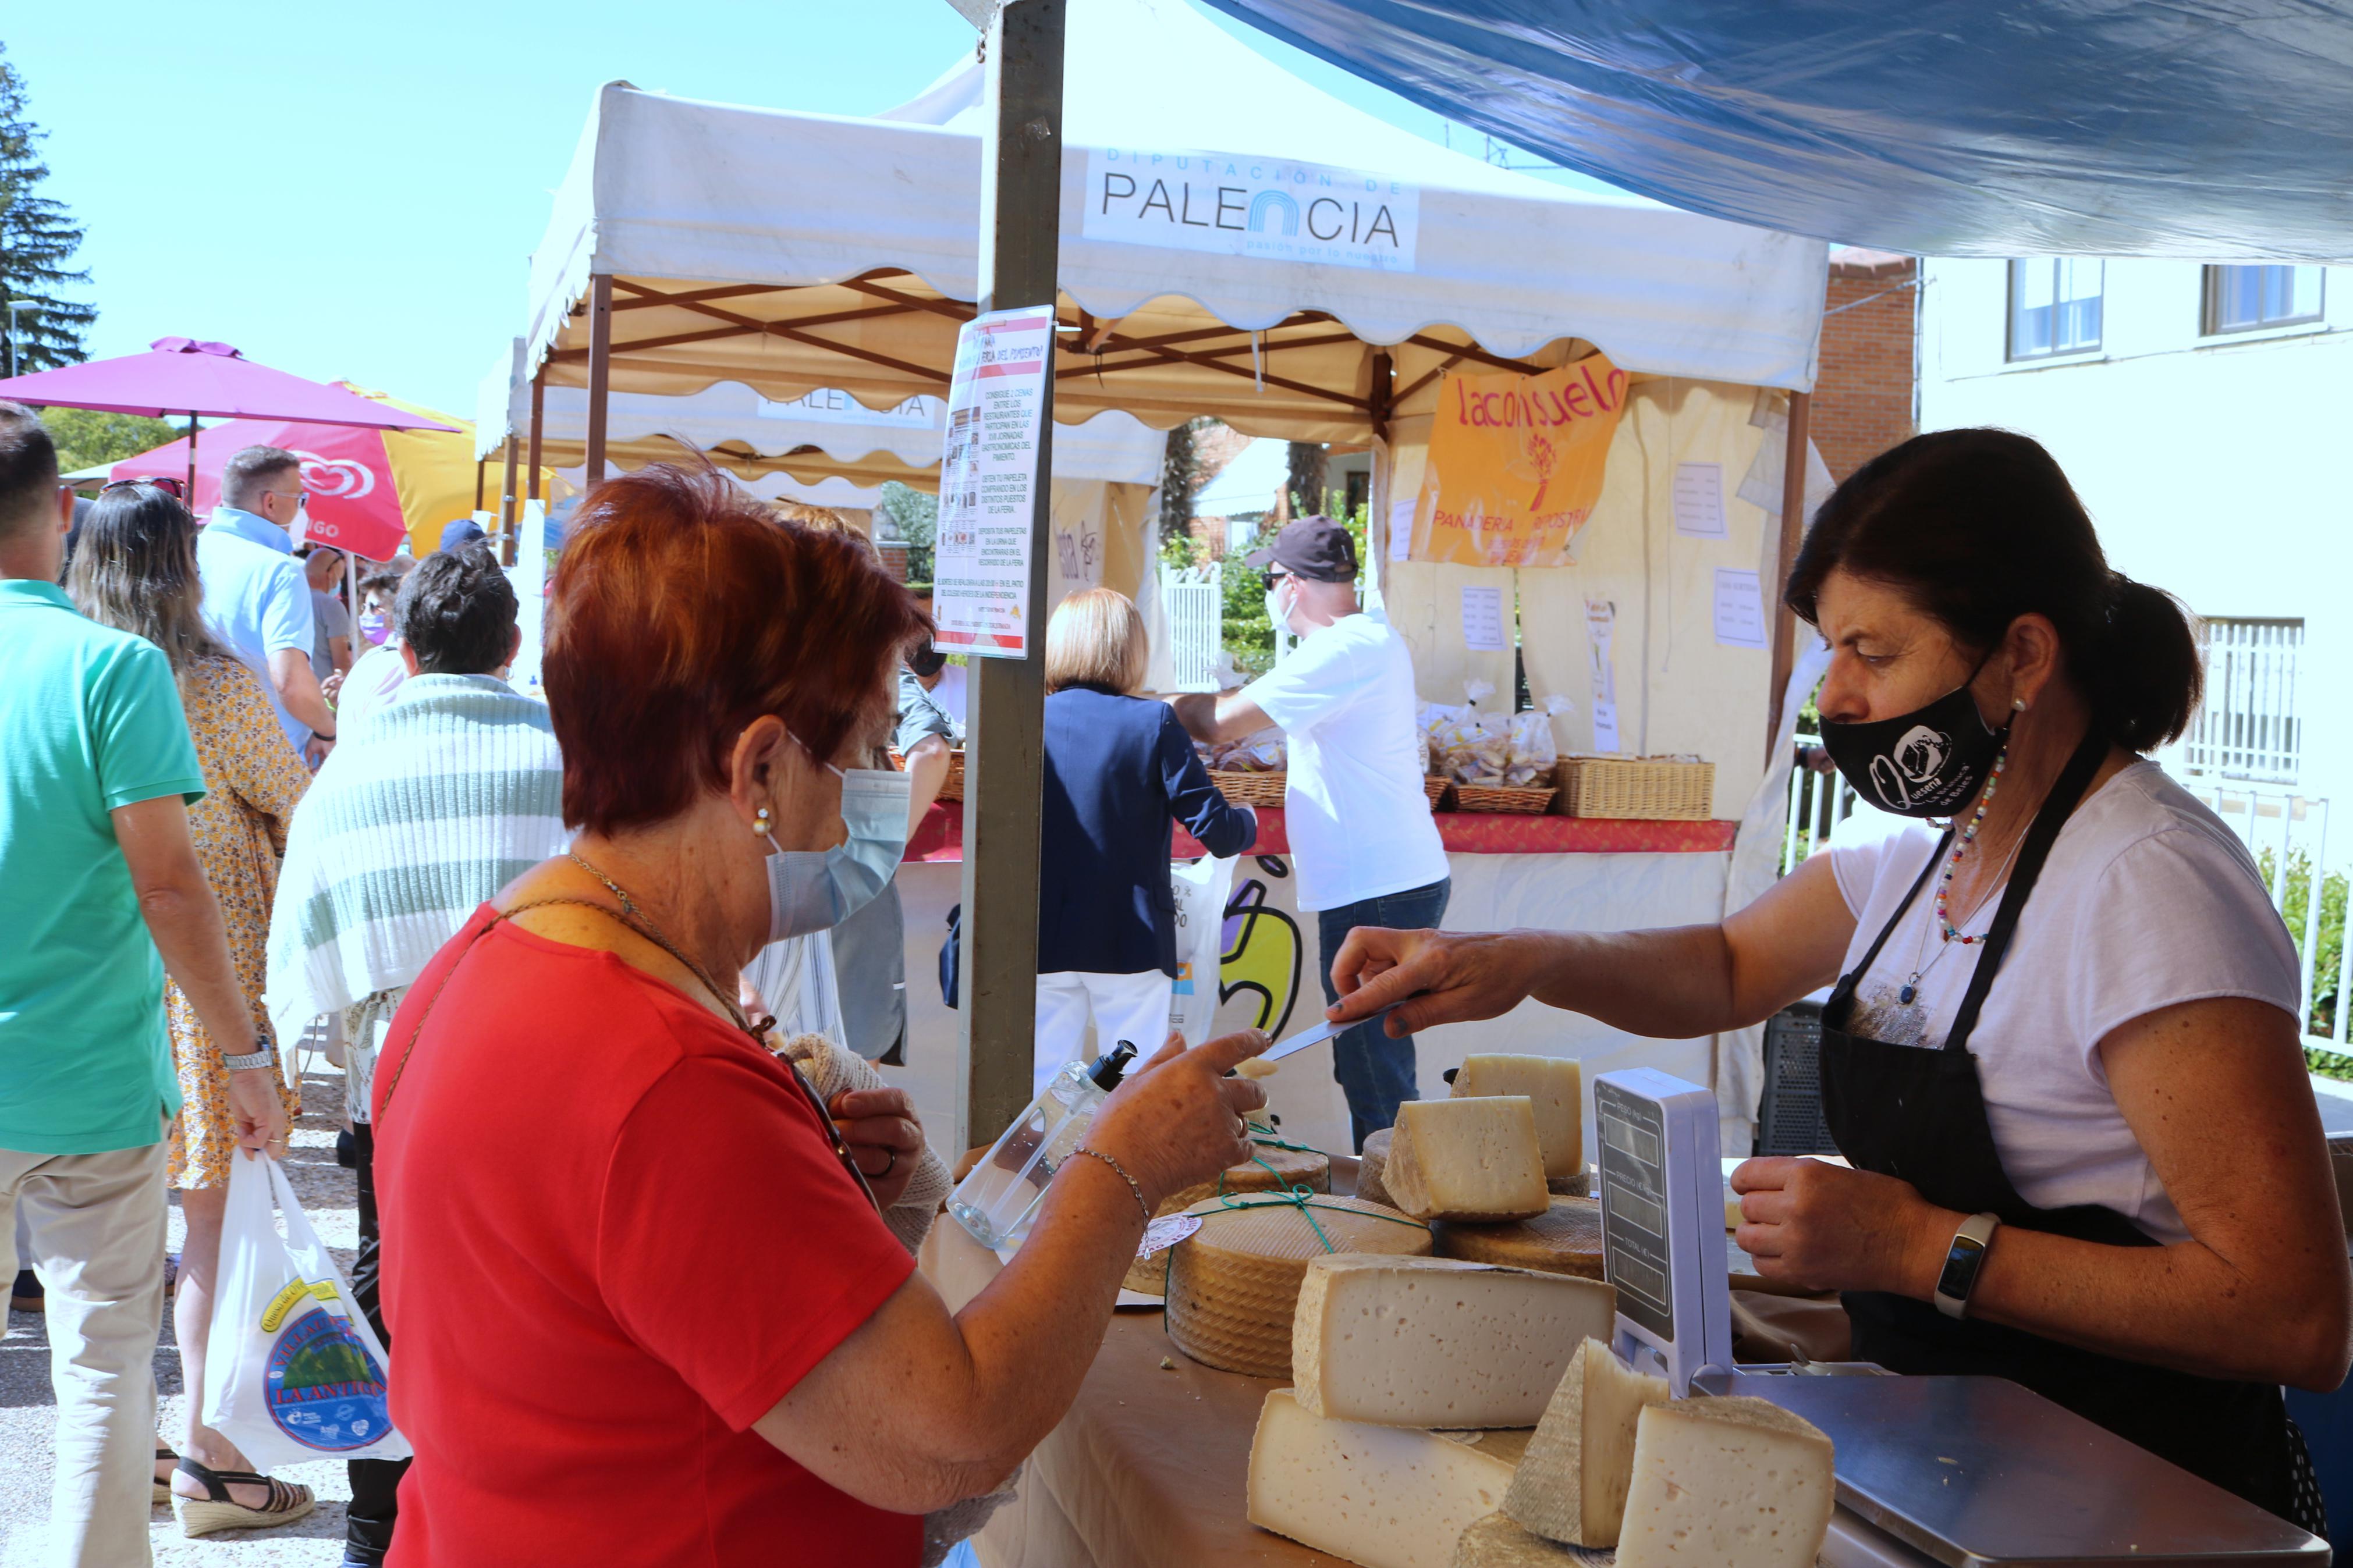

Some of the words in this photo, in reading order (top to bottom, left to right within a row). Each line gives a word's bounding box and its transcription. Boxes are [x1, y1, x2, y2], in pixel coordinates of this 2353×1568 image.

[1107, 147, 1332, 187] DIPUTACIÓN
[1365, 178, 1400, 195] DE
[1247, 239, 1293, 253] pasión
[1300, 246, 1322, 256] por
[1327, 247, 1340, 258] lo
[1346, 250, 1398, 264] nuestro
[985, 390, 1010, 400] CONSIGUE
[993, 400, 1010, 409] ENTRE
[1010, 399, 1021, 408] LOS
[984, 410, 1020, 421] RESTAURANTES
[1020, 409, 1032, 418] QUE
[1011, 421, 1018, 429] EN
[1019, 420, 1030, 429] LAS
[1021, 441, 1031, 450] DEL
[1003, 473, 1027, 482] PAPELETA
[1009, 484, 1016, 493] EN
[1017, 484, 1027, 492] LOS
[988, 506, 995, 514] DE
[307, 517, 340, 539] IGO
[1939, 798, 1953, 806] de
[1617, 1102, 1632, 1116] PESO
[1616, 1170, 1636, 1187] PRECIO
[1624, 1236, 1641, 1253] TOTAL
[1641, 1246, 1650, 1260] (€)
[264, 1303, 283, 1328] Queso
[280, 1293, 291, 1304] de
[276, 1387, 304, 1404] LA
